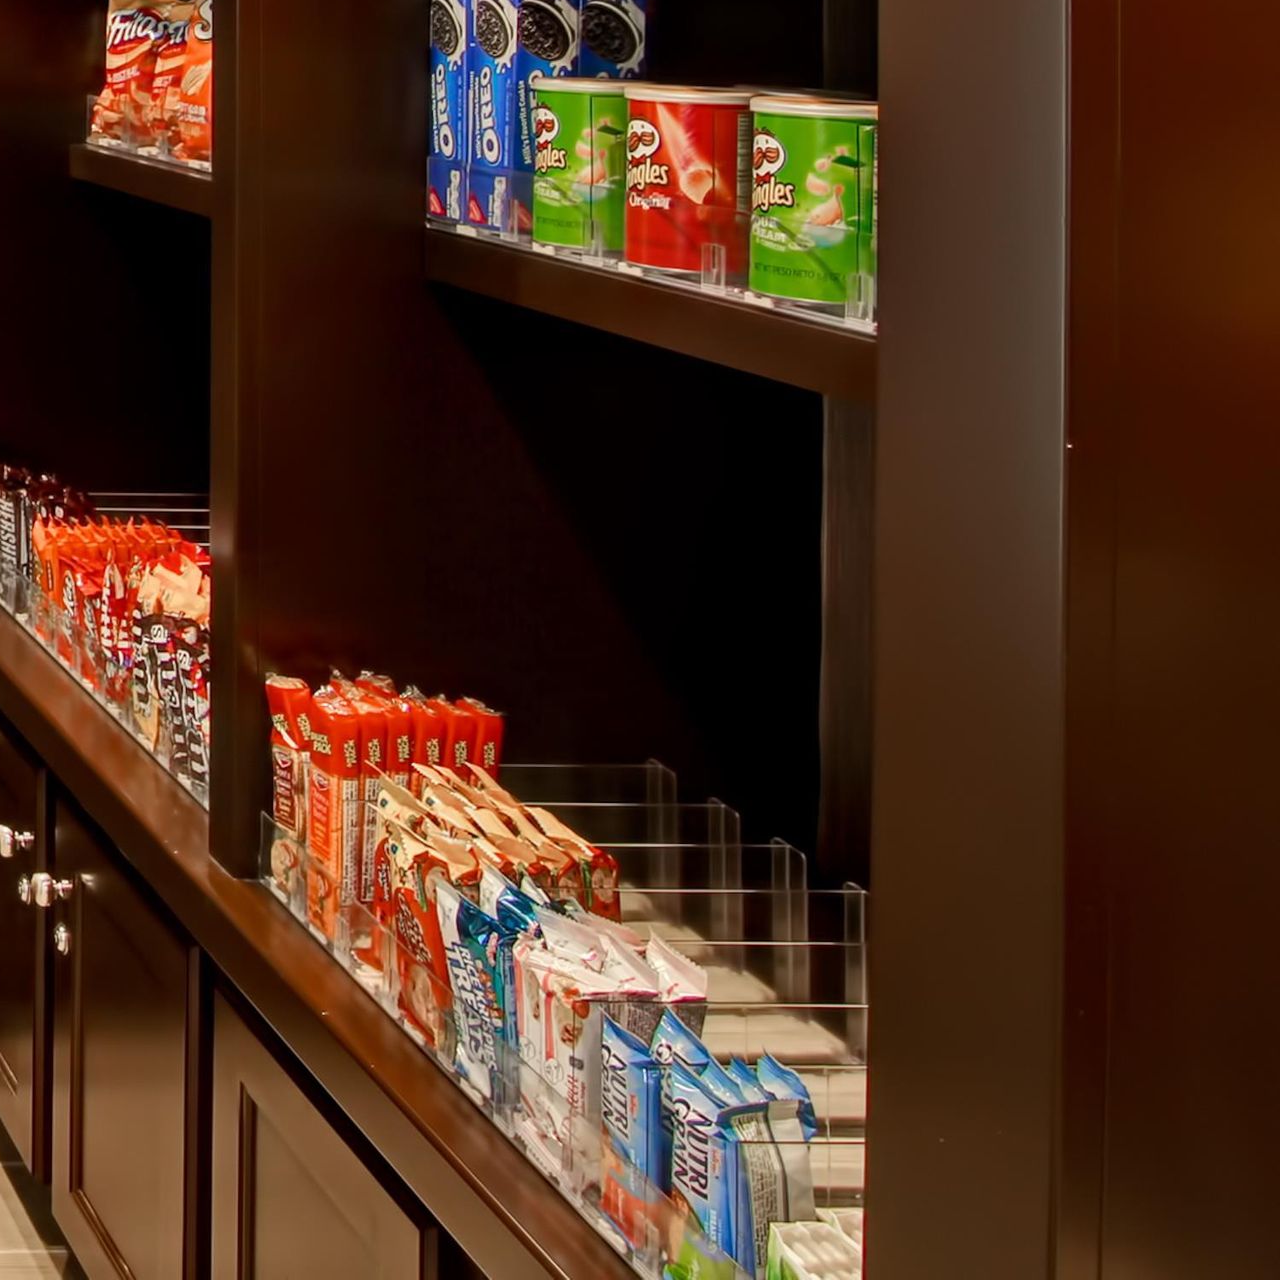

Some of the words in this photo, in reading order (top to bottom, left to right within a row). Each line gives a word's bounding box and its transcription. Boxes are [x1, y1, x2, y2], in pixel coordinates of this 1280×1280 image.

[435, 63, 456, 159] OREO
[480, 66, 502, 166] OREO
[609, 1052, 629, 1139] NUTRI
[688, 1109, 713, 1201] NUTRI
